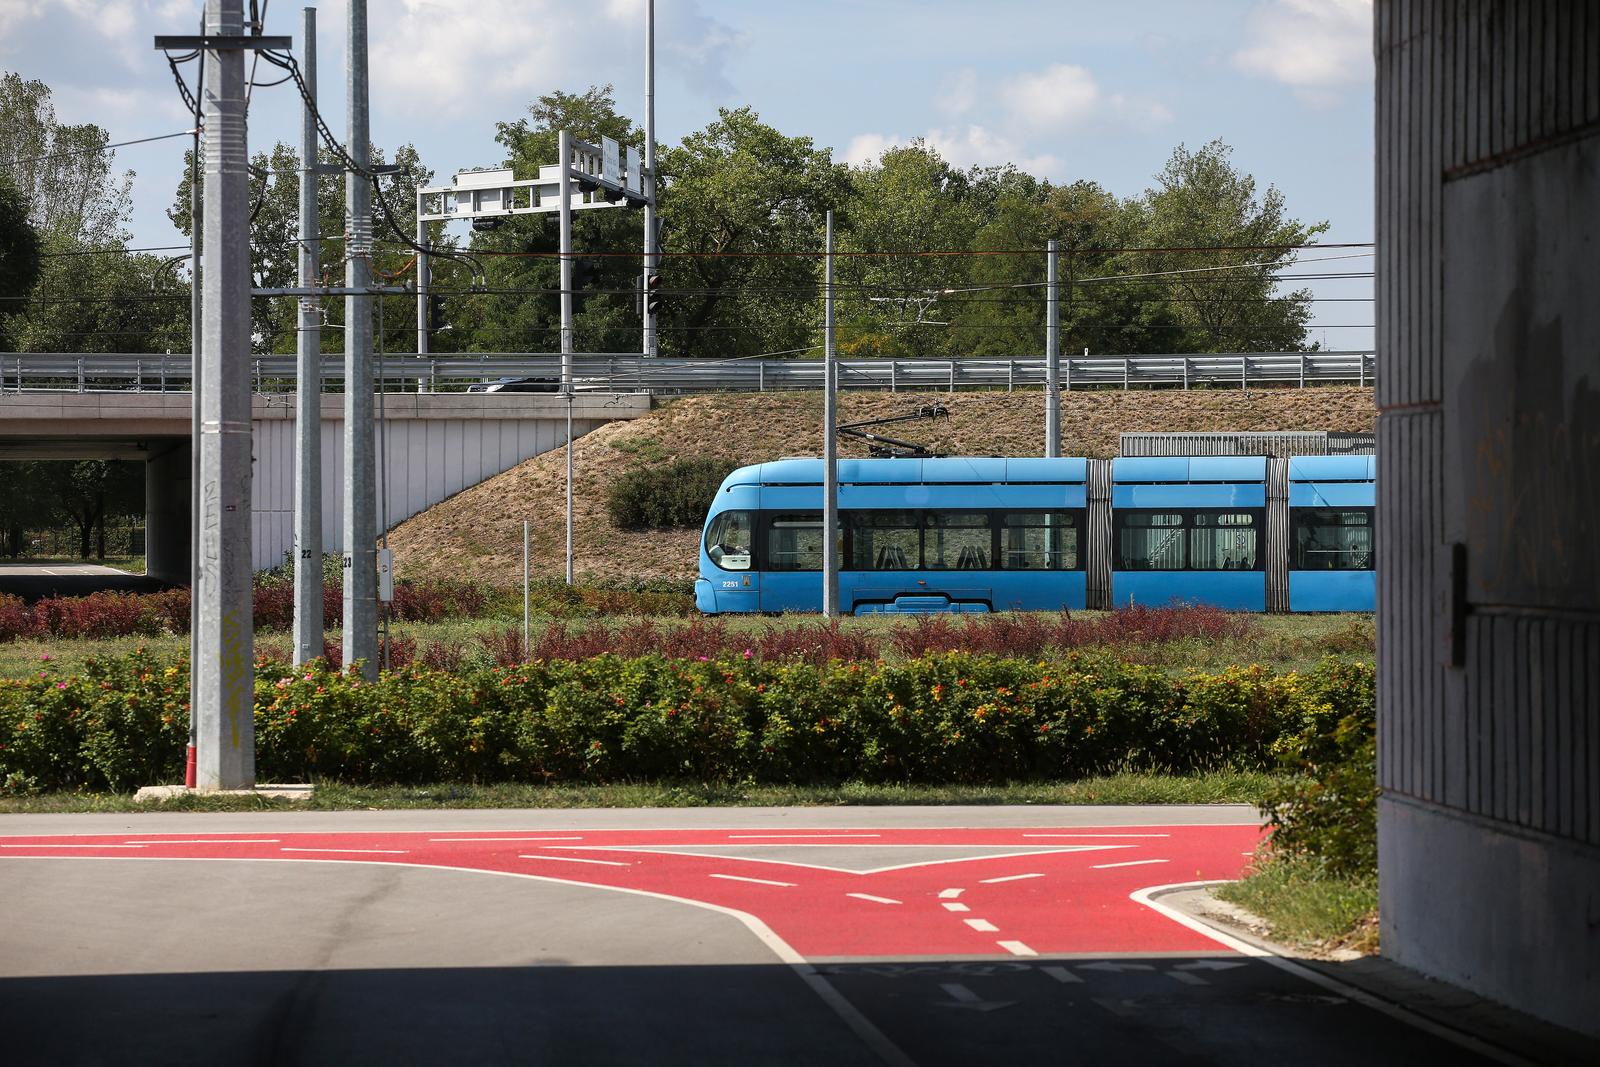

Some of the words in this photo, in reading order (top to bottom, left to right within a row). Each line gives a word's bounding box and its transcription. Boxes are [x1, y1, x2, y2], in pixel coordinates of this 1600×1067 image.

[301, 549, 312, 559] 22
[343, 556, 352, 568] 23
[722, 580, 738, 588] 2251
